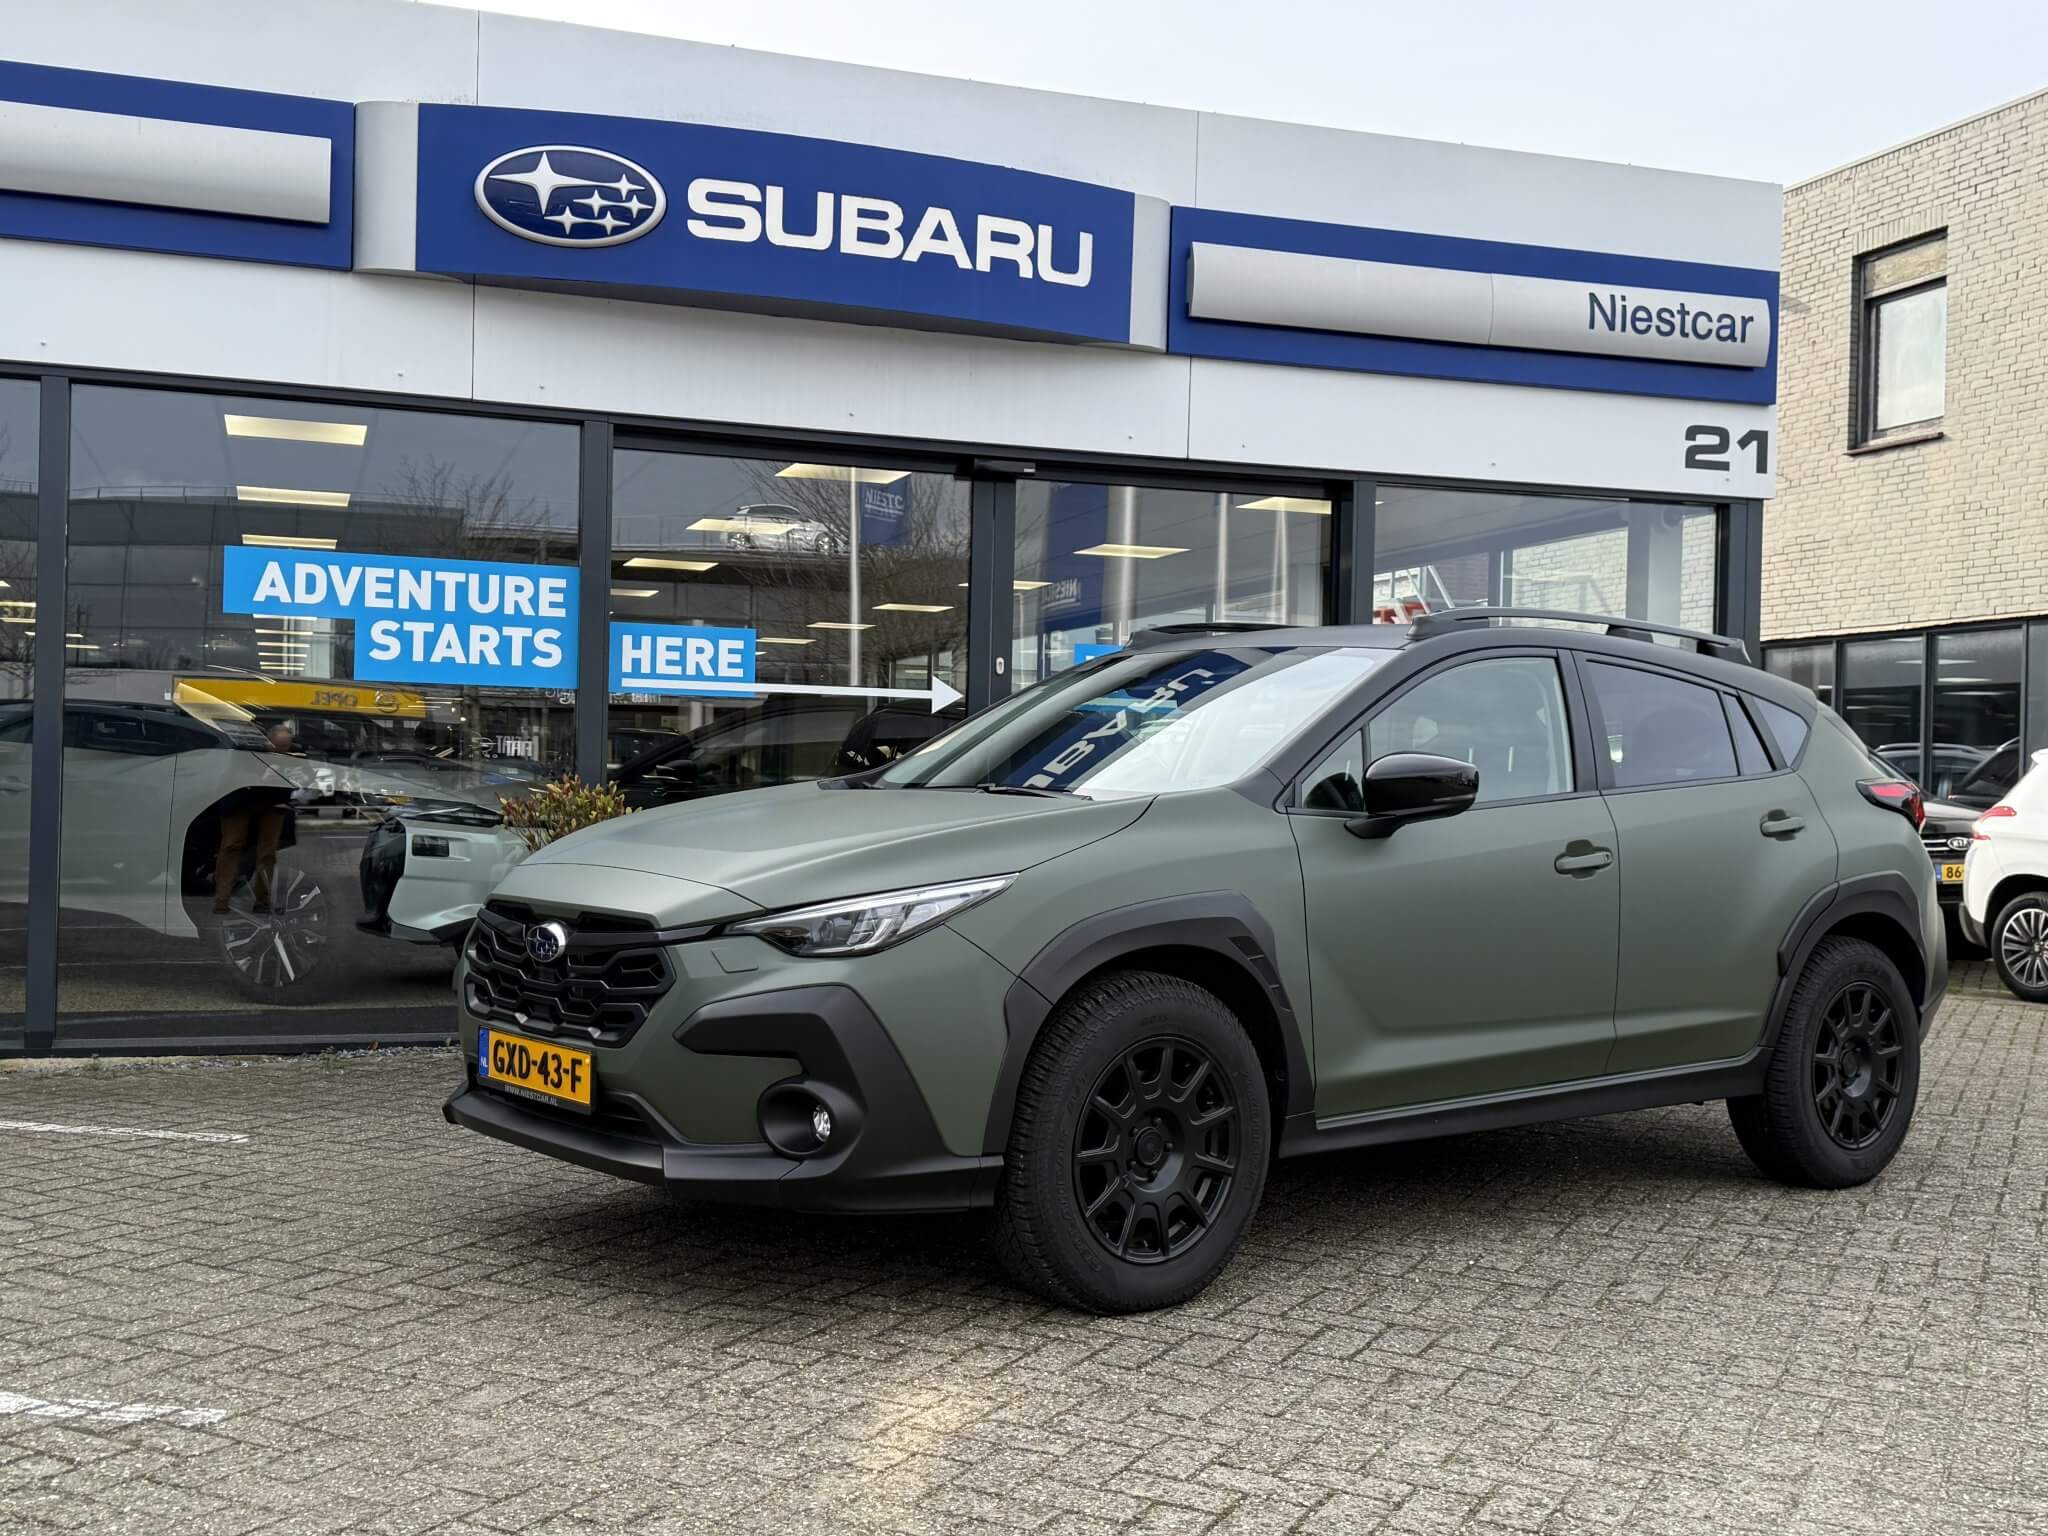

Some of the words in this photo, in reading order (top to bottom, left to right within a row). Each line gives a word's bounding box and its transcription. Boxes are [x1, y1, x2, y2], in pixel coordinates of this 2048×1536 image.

[687, 177, 1094, 288] SUBARU
[1588, 292, 1754, 344] Niestcar
[1684, 424, 1769, 474] 21
[253, 561, 567, 618] ADVENTURE
[370, 620, 562, 668] STARTS
[621, 635, 744, 677] HERE
[493, 1039, 583, 1094] GXD-43-F
